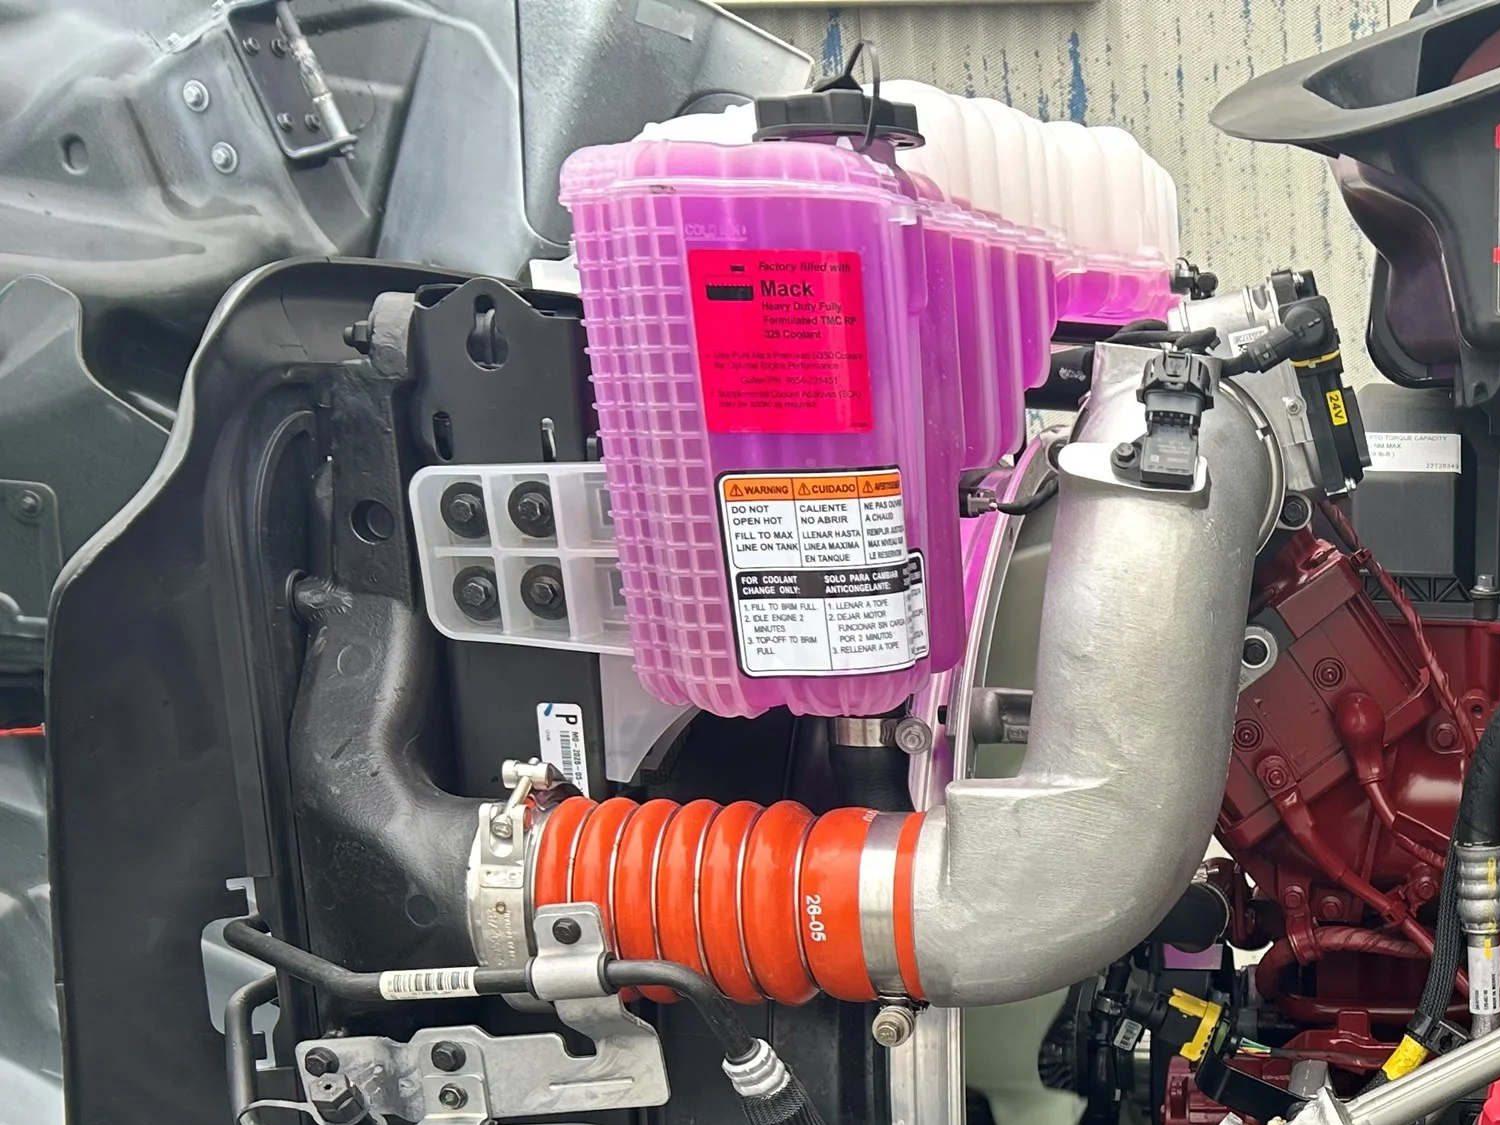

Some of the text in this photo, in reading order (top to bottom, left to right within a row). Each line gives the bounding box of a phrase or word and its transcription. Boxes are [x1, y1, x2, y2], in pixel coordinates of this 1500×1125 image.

[760, 261, 851, 273] Factory filled with
[760, 279, 815, 297] Mack
[762, 302, 842, 312] Heavy Duty Fully
[763, 315, 856, 325] Formulated TMC RP
[764, 330, 821, 339] 329 Coolant
[1329, 394, 1343, 420] 24V
[744, 486, 789, 495] WARNING
[811, 484, 856, 494] CUIDADO
[731, 504, 769, 514] DO NOT
[799, 503, 847, 513] CALIENTE
[863, 502, 873, 510] NE
[733, 516, 783, 526] OPEN HOT
[801, 515, 848, 525] NO ABRIR
[865, 513, 871, 521] A
[735, 531, 793, 540] FILL TO MAX
[802, 529, 861, 539] LLENAR HASTA
[736, 542, 799, 552] LINE ON TANK
[804, 541, 860, 551] LINEA MAXIMA
[805, 553, 850, 563] EN TANQUE
[740, 575, 798, 585] FOR COOLANT
[824, 570, 899, 583] SOLO PARA CAMBIAR
[742, 586, 801, 595] CHANGE ONLY:
[825, 581, 892, 594] ANTICONGELANTE:
[751, 603, 765, 611] FILL
[828, 598, 888, 611] 1. LLENAR A TOPE
[752, 614, 769, 622] IDLE
[828, 610, 887, 621] 2. DEJAR MOTOR
[754, 625, 786, 633] MINUTES
[838, 622, 877, 632] FUNCIONAR
[878, 621, 888, 629] SIN
[747, 637, 754, 645] 3.
[755, 636, 787, 644] TOP-OFF
[801, 635, 817, 643] BRIM
[840, 634, 856, 643] POR
[865, 631, 893, 641] MINUTOS
[757, 647, 774, 655] FULL
[832, 640, 900, 654] 3. RELLENAR A TOPE
[555, 714, 578, 725] P
[805, 894, 827, 942] 26-05
